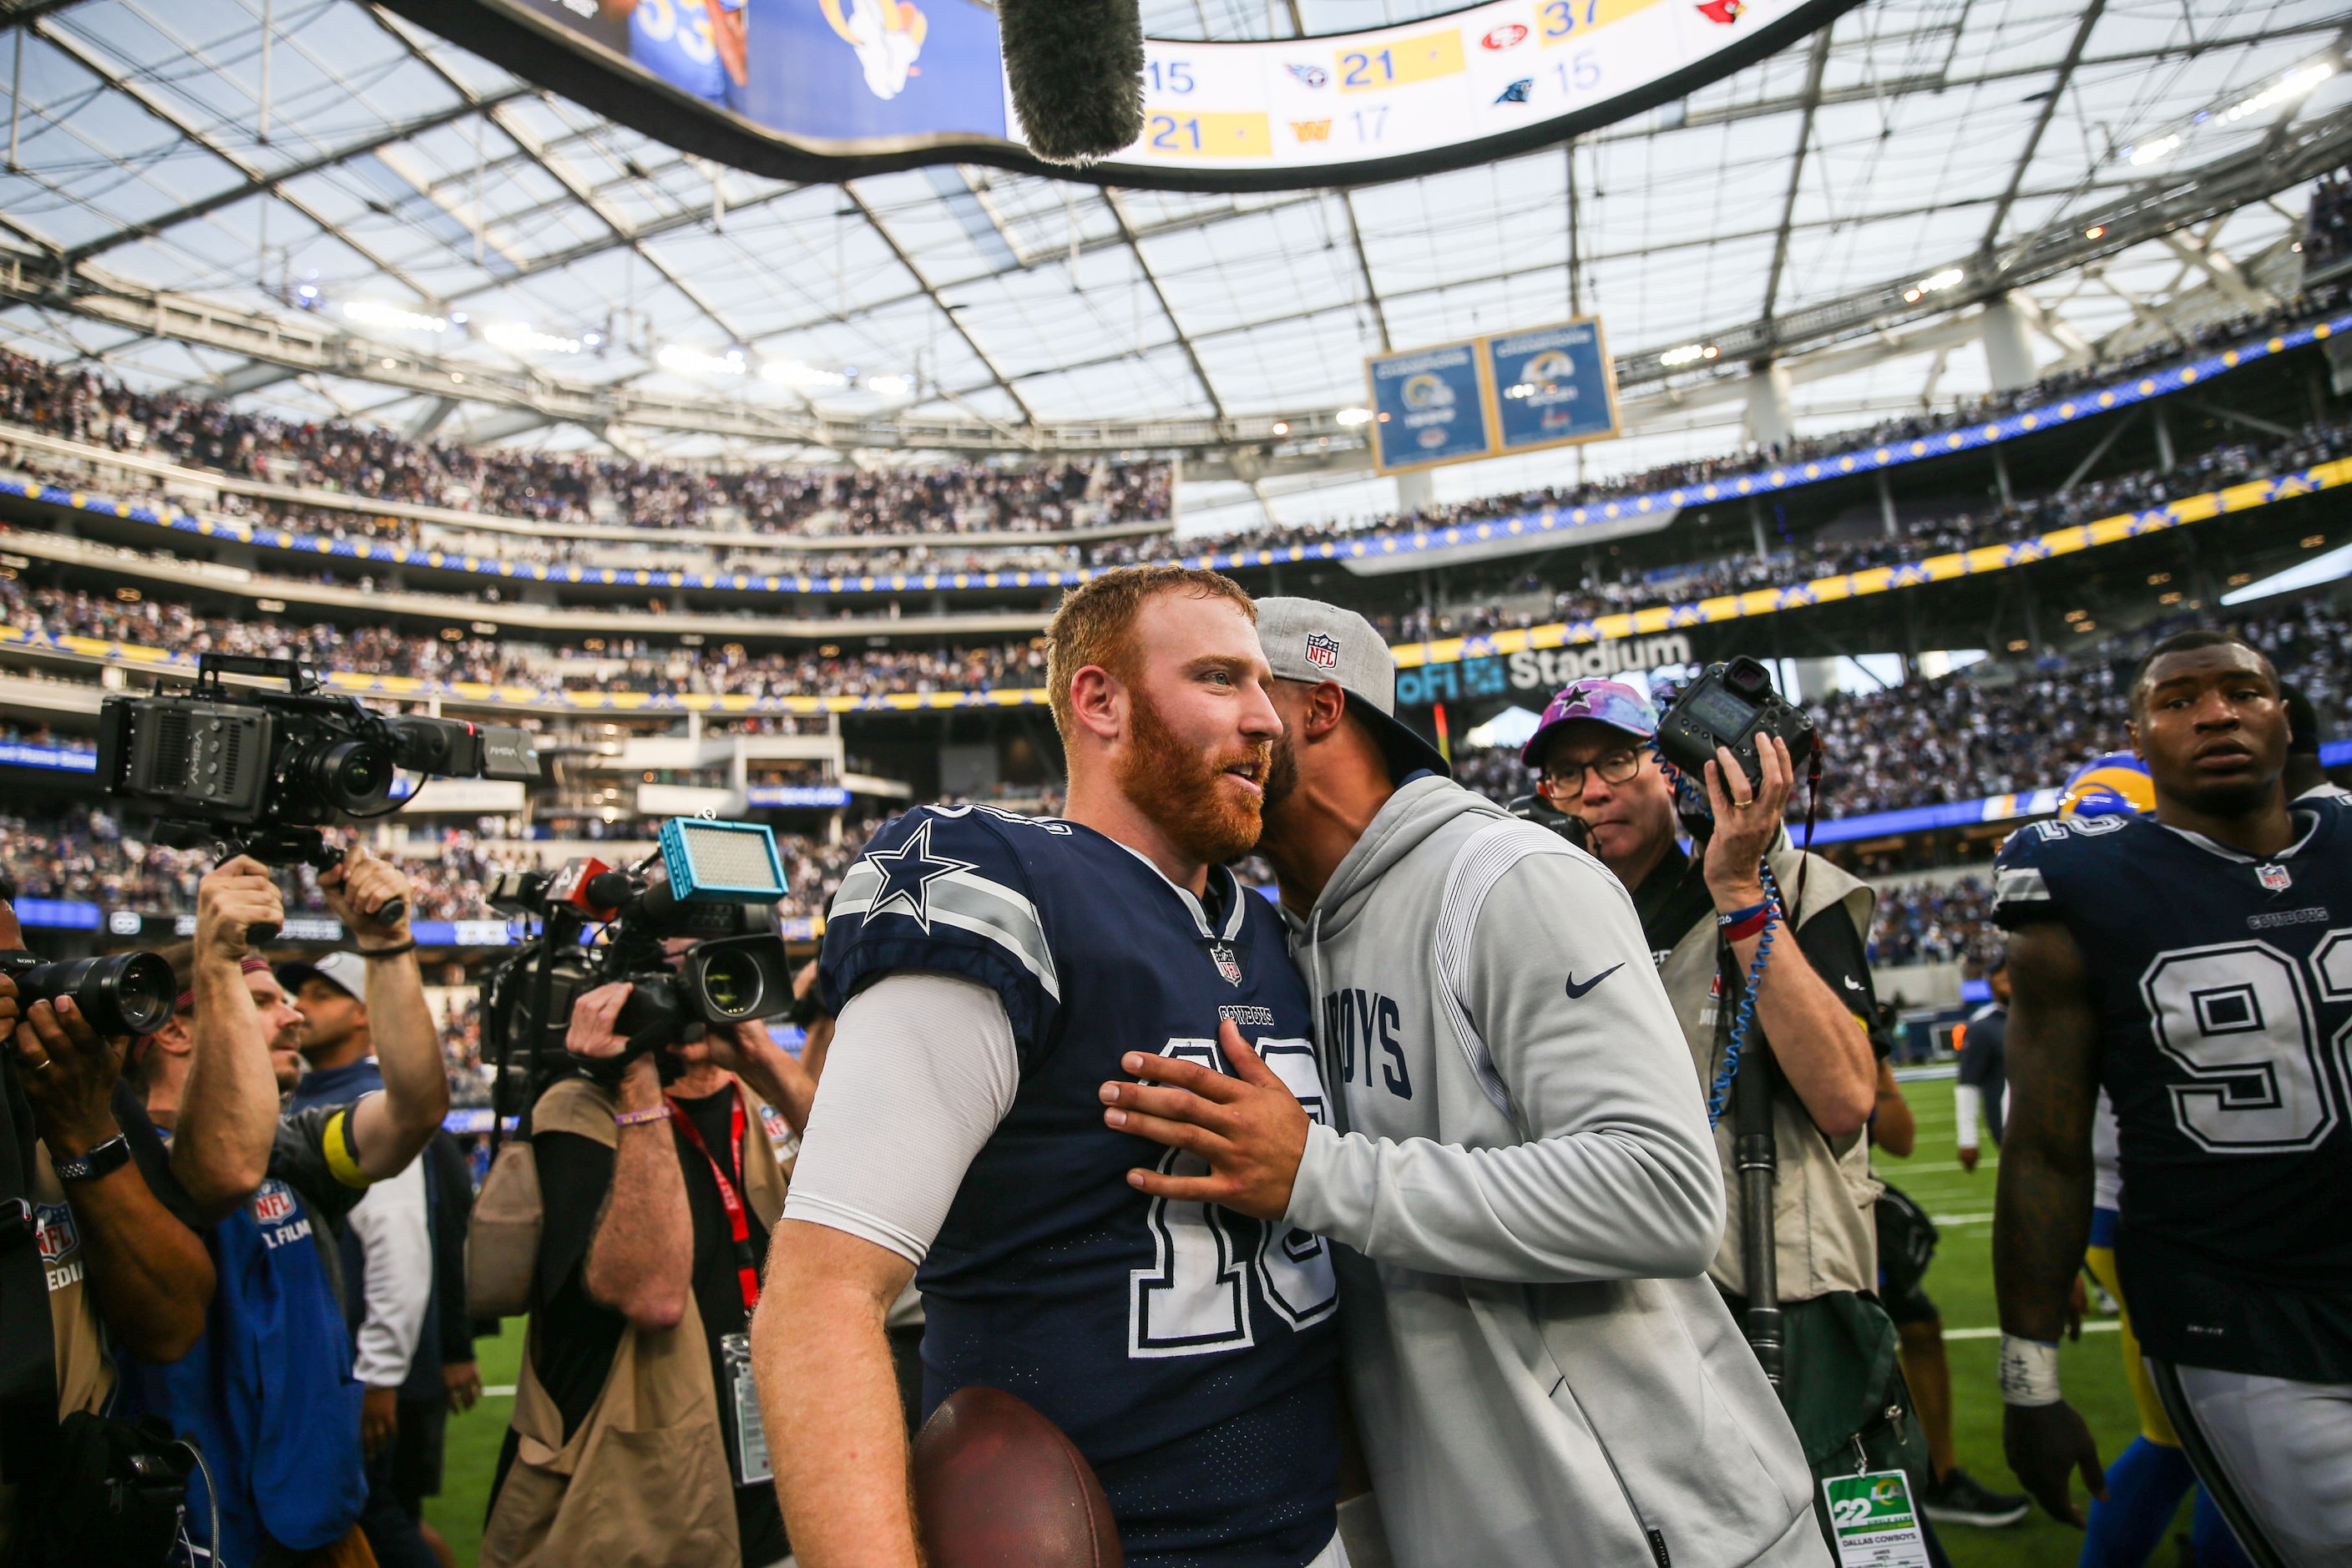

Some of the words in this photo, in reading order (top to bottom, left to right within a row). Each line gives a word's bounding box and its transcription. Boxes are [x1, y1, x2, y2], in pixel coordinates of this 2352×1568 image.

[1147, 61, 1194, 94] 15
[1342, 49, 1393, 86] 21
[1151, 116, 1201, 150] 21
[1351, 106, 1389, 142] 17
[1308, 646, 1334, 665] NFL
[1509, 632, 1692, 689] Stadium
[190, 728, 204, 785] AMIRA
[2246, 907, 2330, 930] COWBOYS
[1221, 962, 1240, 979] NFL
[1218, 1004, 1275, 1027] COWBOYS
[255, 1194, 292, 1219] NFL
[1834, 1497, 1872, 1529] 22
[1654, 1533, 1667, 1565] ON-FIELD
[1842, 1536, 1874, 1547] DALLAS
[1874, 1533, 1916, 1543] COWBOYS
